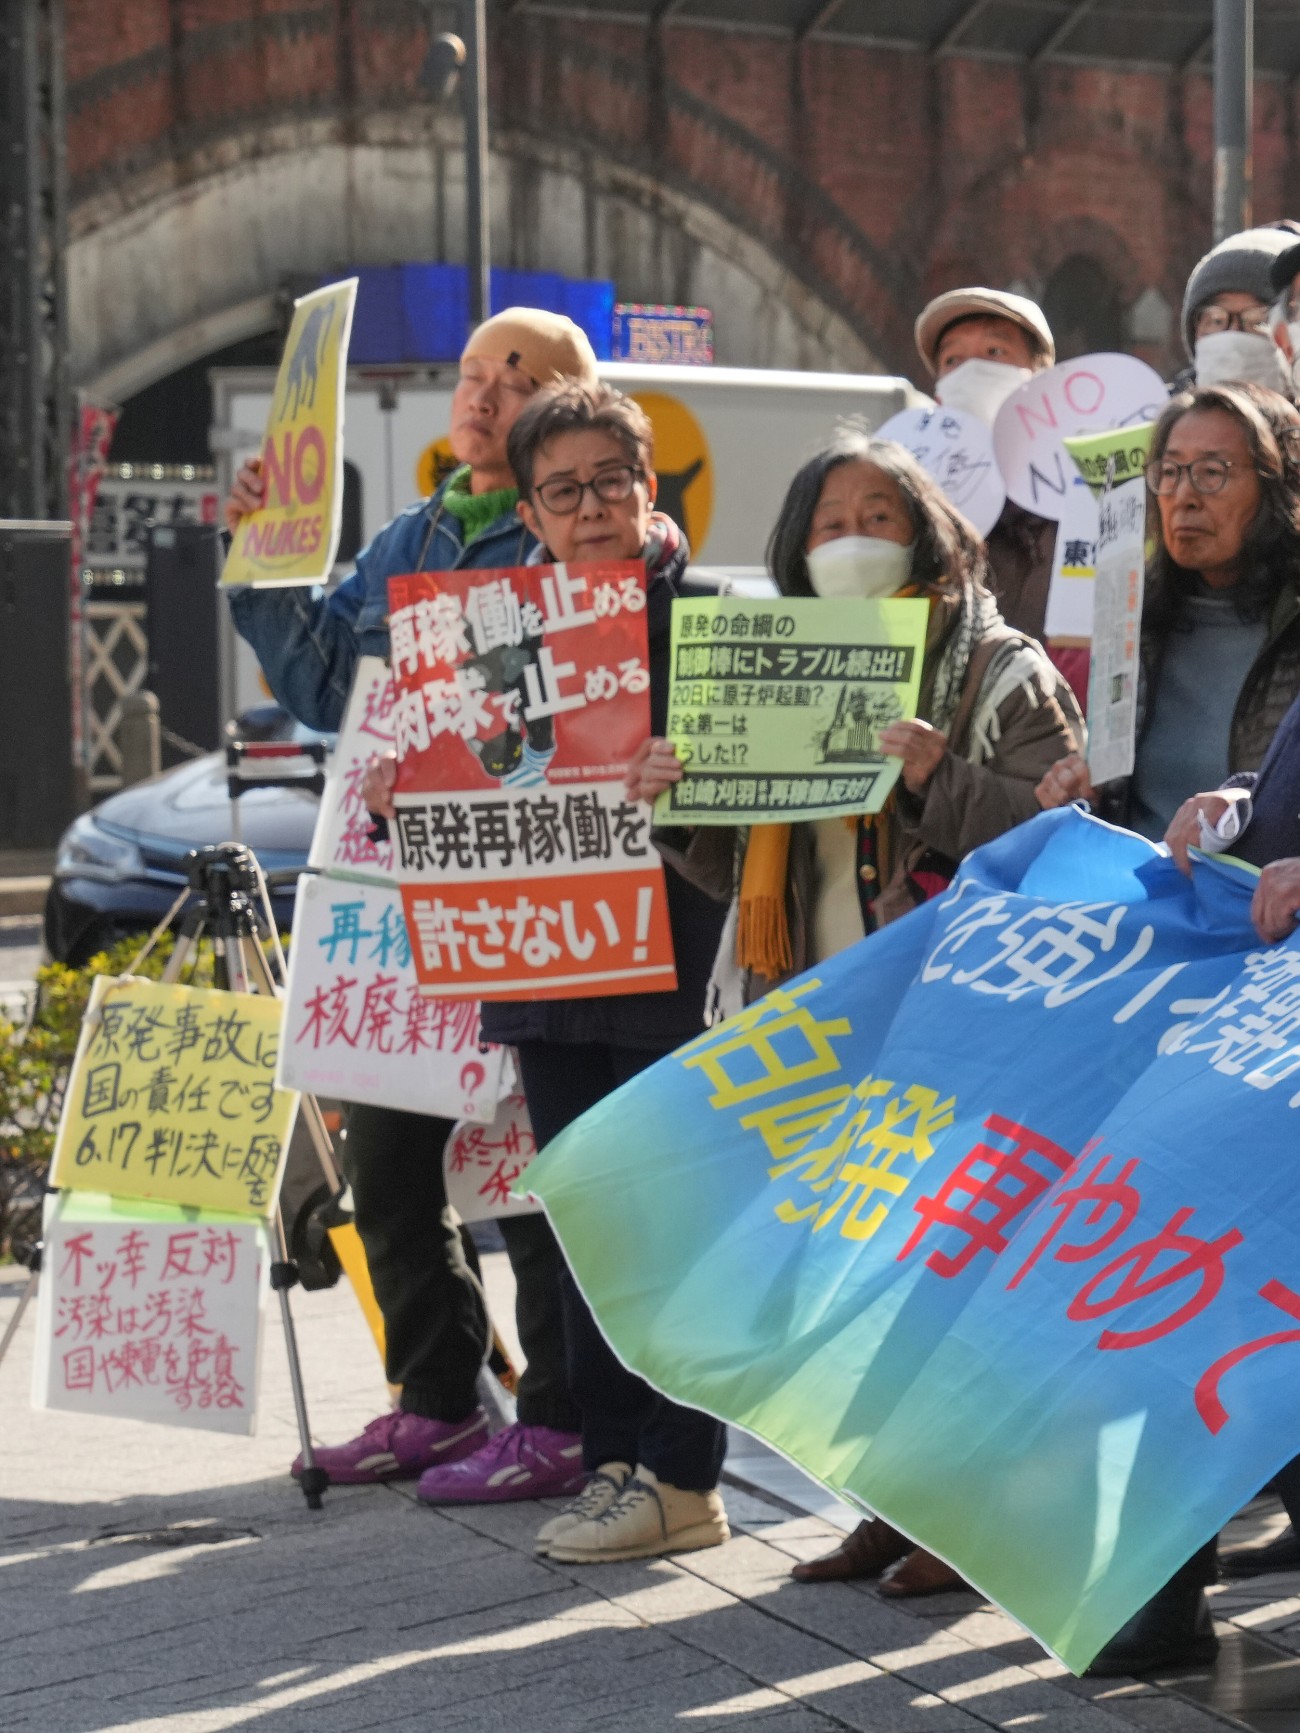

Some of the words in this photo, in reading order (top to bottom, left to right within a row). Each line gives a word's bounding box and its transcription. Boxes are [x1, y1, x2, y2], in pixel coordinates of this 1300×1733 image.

[1014, 370, 1105, 440] NO
[259, 424, 327, 506] NO
[242, 514, 322, 558] NUKES
[389, 562, 647, 683] 再稼働を止める
[679, 612, 796, 638] 原発の命綱の
[391, 646, 650, 763] 肉球で止める
[396, 790, 648, 872] 原発再稼働を
[412, 886, 653, 972] 許さない！
[86, 1002, 280, 1068] 原発事故は
[82, 1062, 276, 1123] 国の責任です
[53, 1287, 216, 1341] 汚染は汚染
